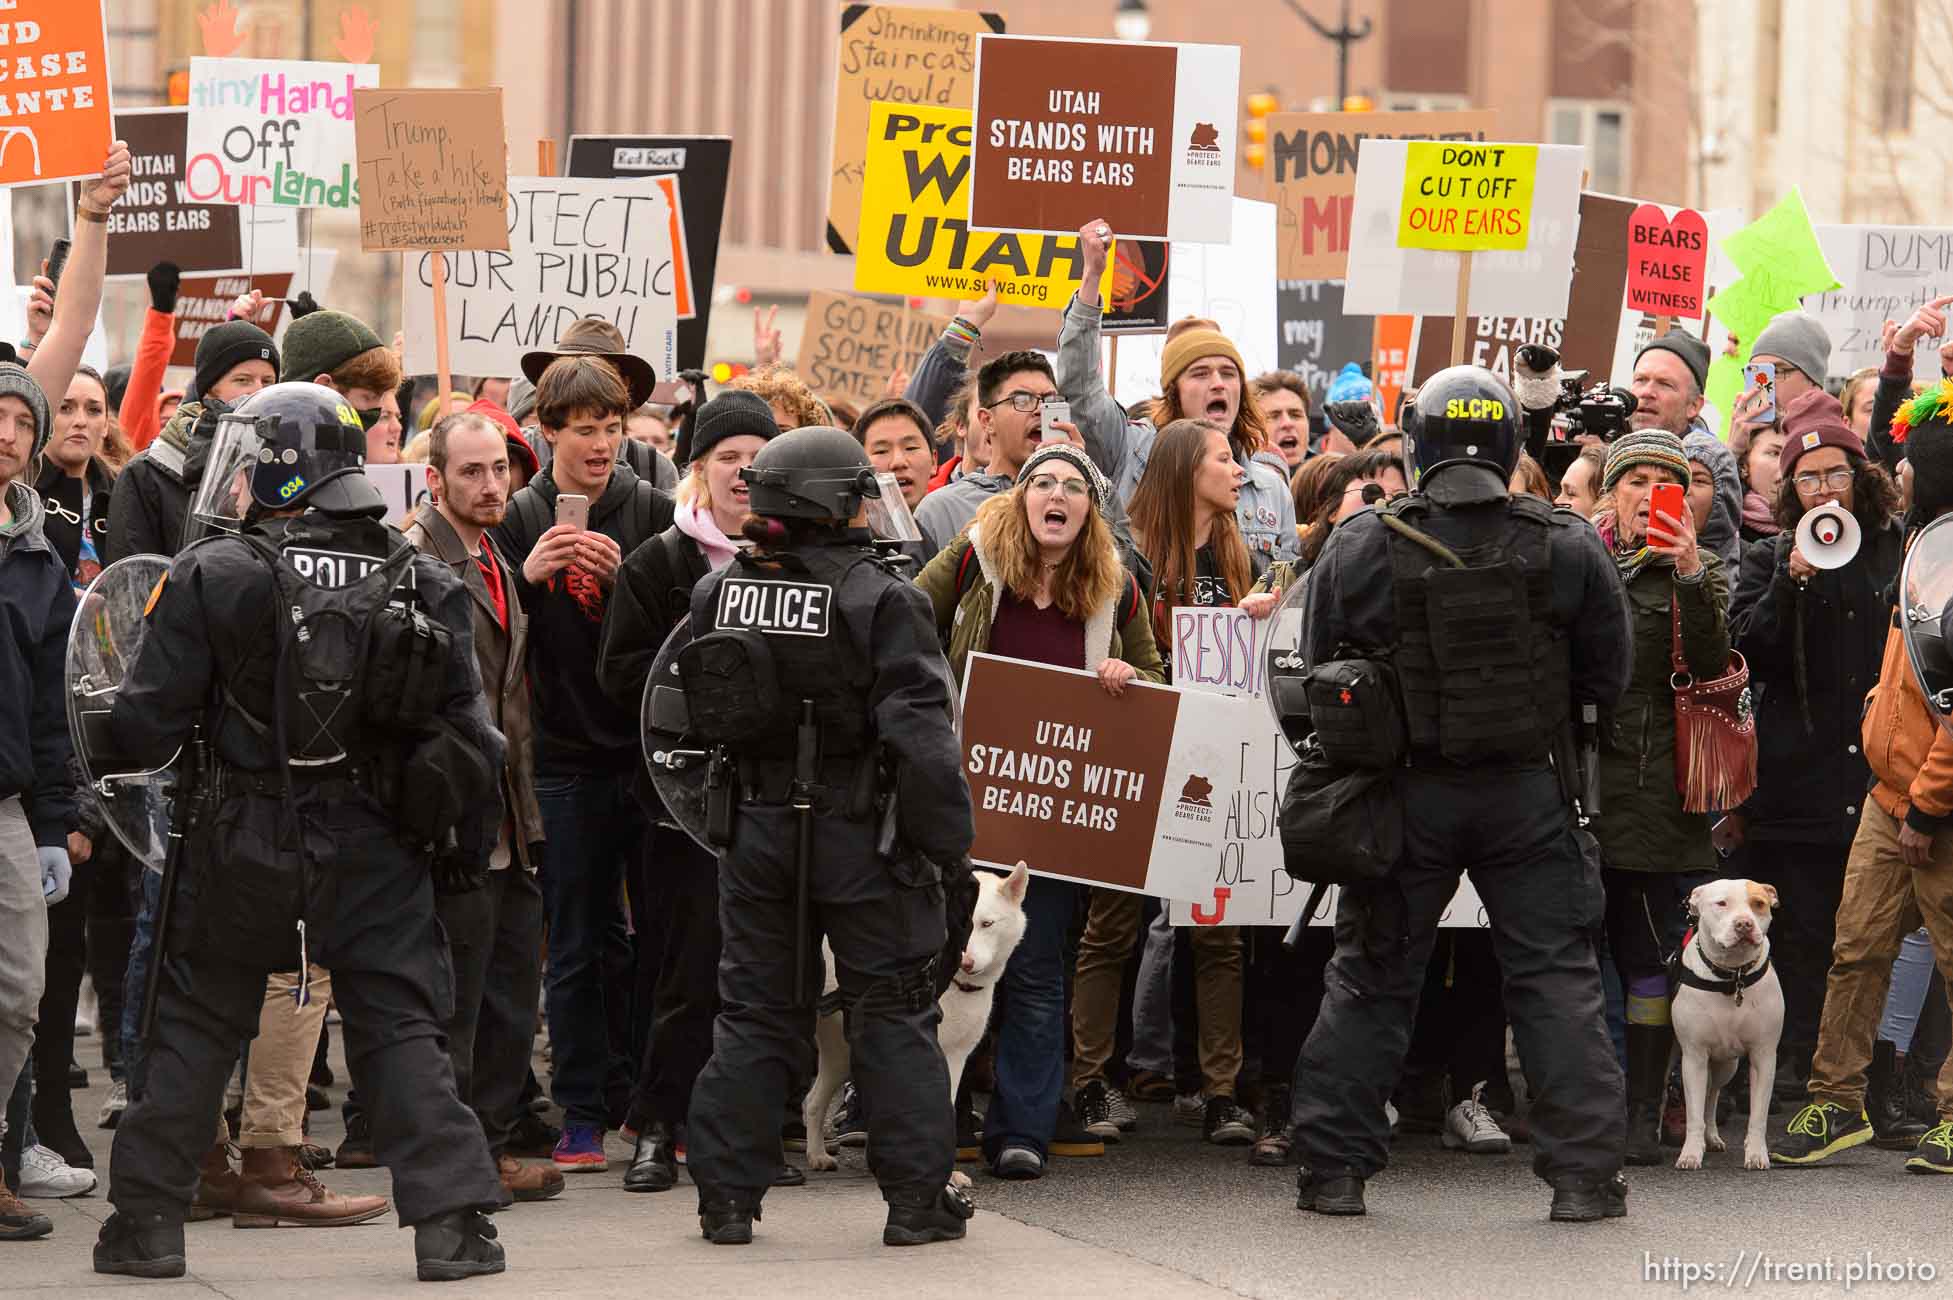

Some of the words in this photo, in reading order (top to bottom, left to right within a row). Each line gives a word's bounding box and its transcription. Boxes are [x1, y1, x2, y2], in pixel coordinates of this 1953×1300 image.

[868, 7, 970, 50] Shrinking
[843, 39, 975, 74] Staircas
[260, 73, 356, 121] Hand
[863, 74, 955, 104] Would
[1048, 89, 1101, 115] UTAH
[222, 119, 301, 169] Off
[990, 118, 1087, 152] STANDS
[1097, 124, 1155, 155] WITH
[131, 154, 176, 176] UTAH
[361, 151, 425, 198] Take
[1007, 157, 1074, 184] BEARS
[1081, 160, 1135, 187] EARS
[1442, 148, 1505, 168] DON'T
[1476, 178, 1517, 199] OFF
[106, 211, 161, 234] BEARS
[166, 209, 210, 231] EARS
[1408, 207, 1459, 236] OUR
[1463, 208, 1522, 236] EARS
[1633, 224, 1702, 251] BEARS
[885, 213, 1084, 281] UTAH
[418, 250, 515, 293] OUR
[535, 252, 672, 298] PUBLIC
[1640, 260, 1692, 282] FALSE
[1631, 287, 1697, 311] WITNESS
[460, 299, 639, 349] LAND!!
[824, 300, 866, 335] GO
[1476, 315, 1564, 349] BEARS
[813, 332, 889, 369] SOME
[1283, 318, 1324, 359] my
[1446, 398, 1504, 421] SLCPD
[280, 476, 305, 498] 034
[722, 584, 823, 631] POLICE
[1035, 720, 1093, 753] UTAH
[968, 743, 1073, 789] STANDS
[1083, 763, 1146, 802] WITH
[982, 785, 1055, 820] BEARS
[1061, 799, 1119, 832] EARS
